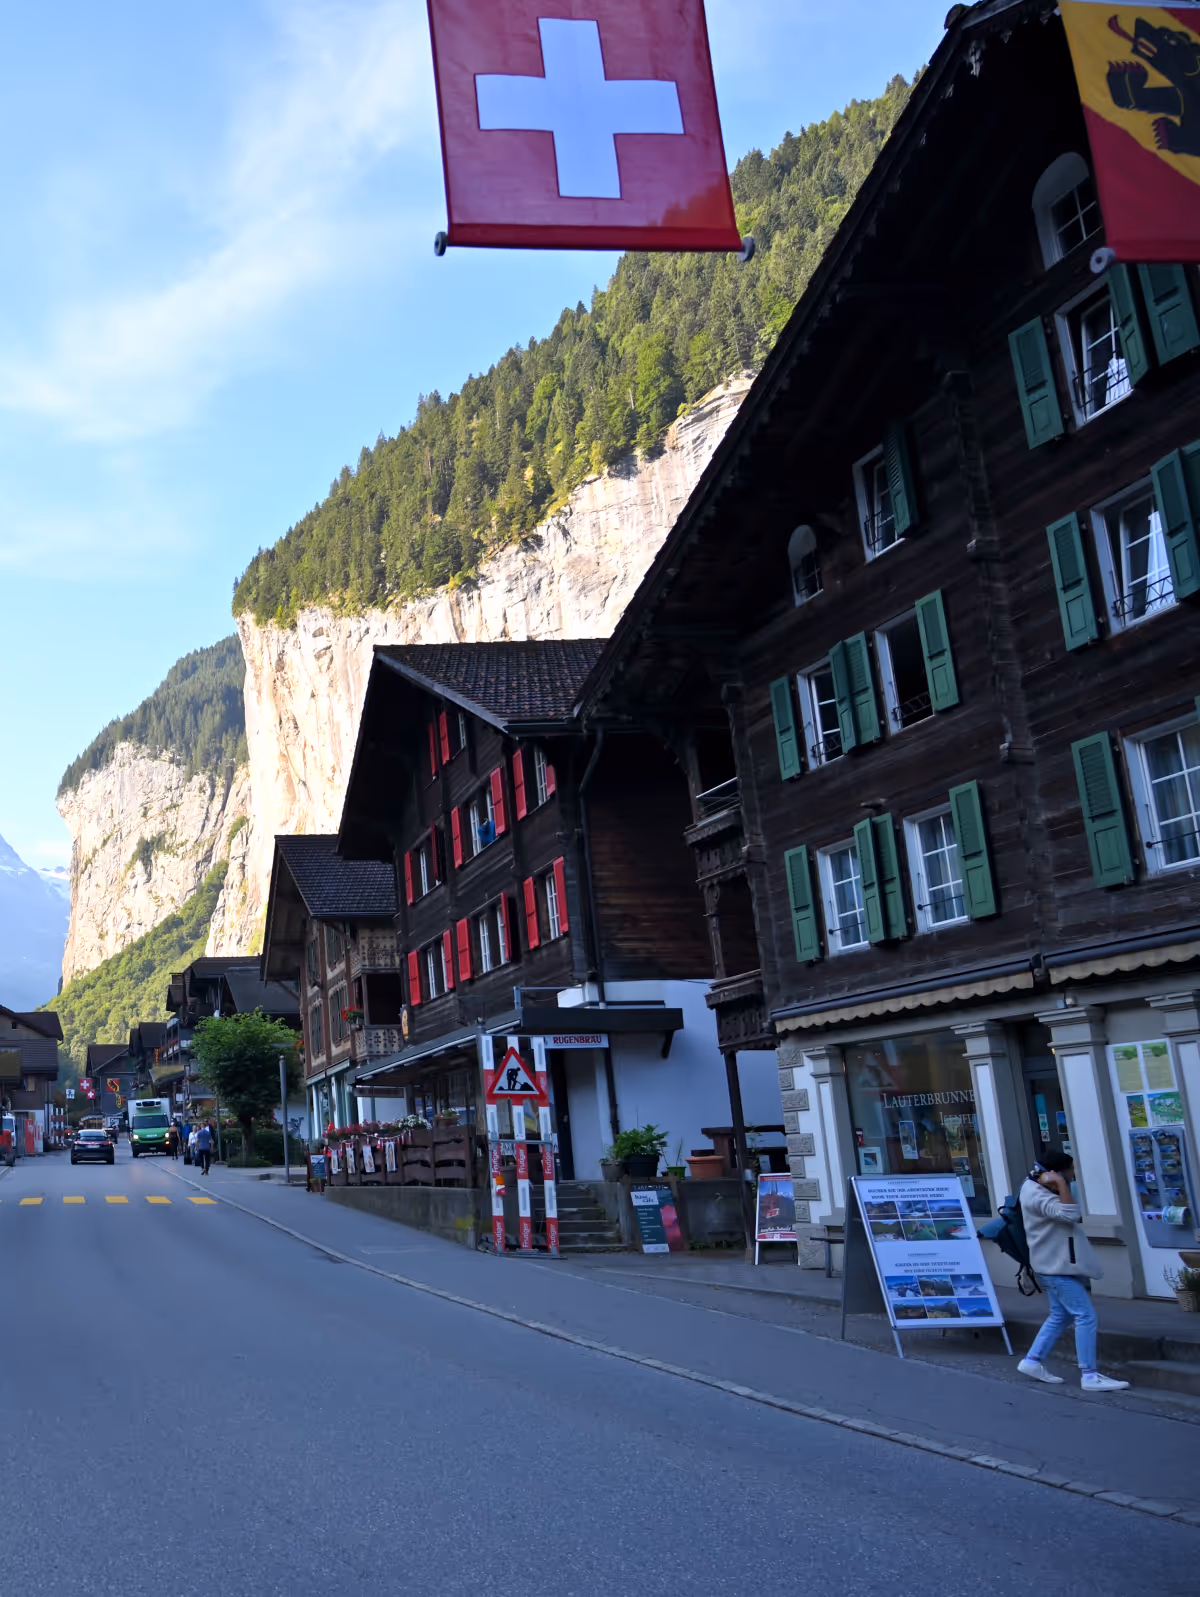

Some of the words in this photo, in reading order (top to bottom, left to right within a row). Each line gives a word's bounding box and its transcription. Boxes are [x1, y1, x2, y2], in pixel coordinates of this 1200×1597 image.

[518, 1148, 526, 1174] Frutiger
[545, 1150, 553, 1175] Frutige
[522, 1222, 531, 1248] Frutiger
